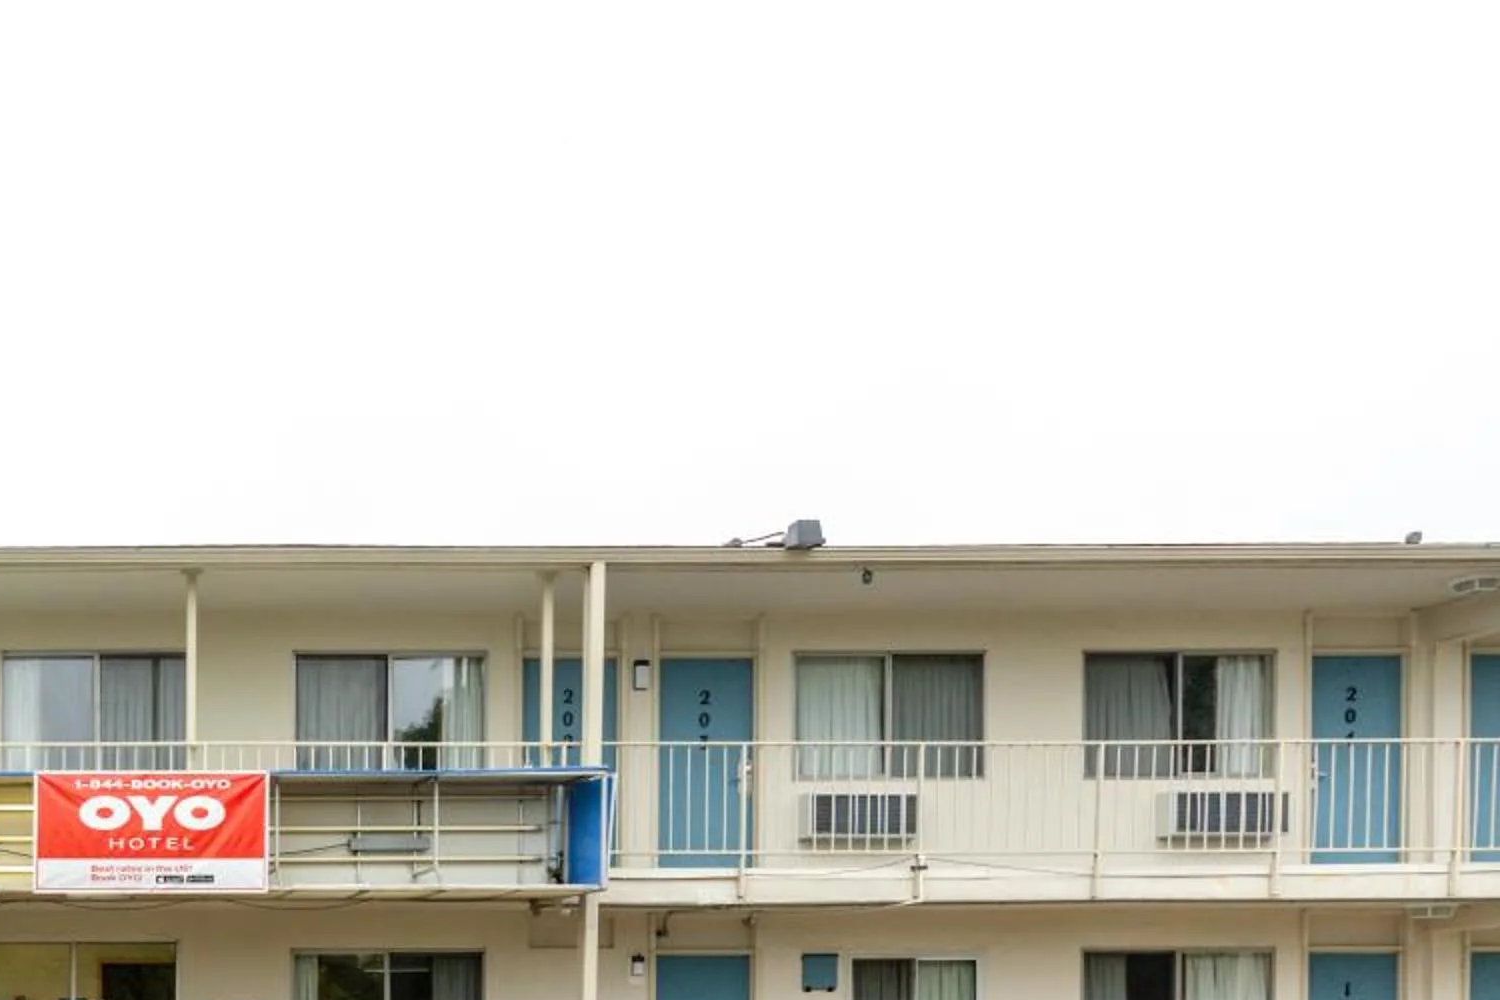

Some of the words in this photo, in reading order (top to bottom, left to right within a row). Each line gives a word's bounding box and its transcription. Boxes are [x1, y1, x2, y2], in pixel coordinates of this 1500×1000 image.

[74, 778, 232, 790] 1-844-BOOK-OYO
[79, 795, 226, 831] OYO
[108, 837, 196, 851] HOTEL
